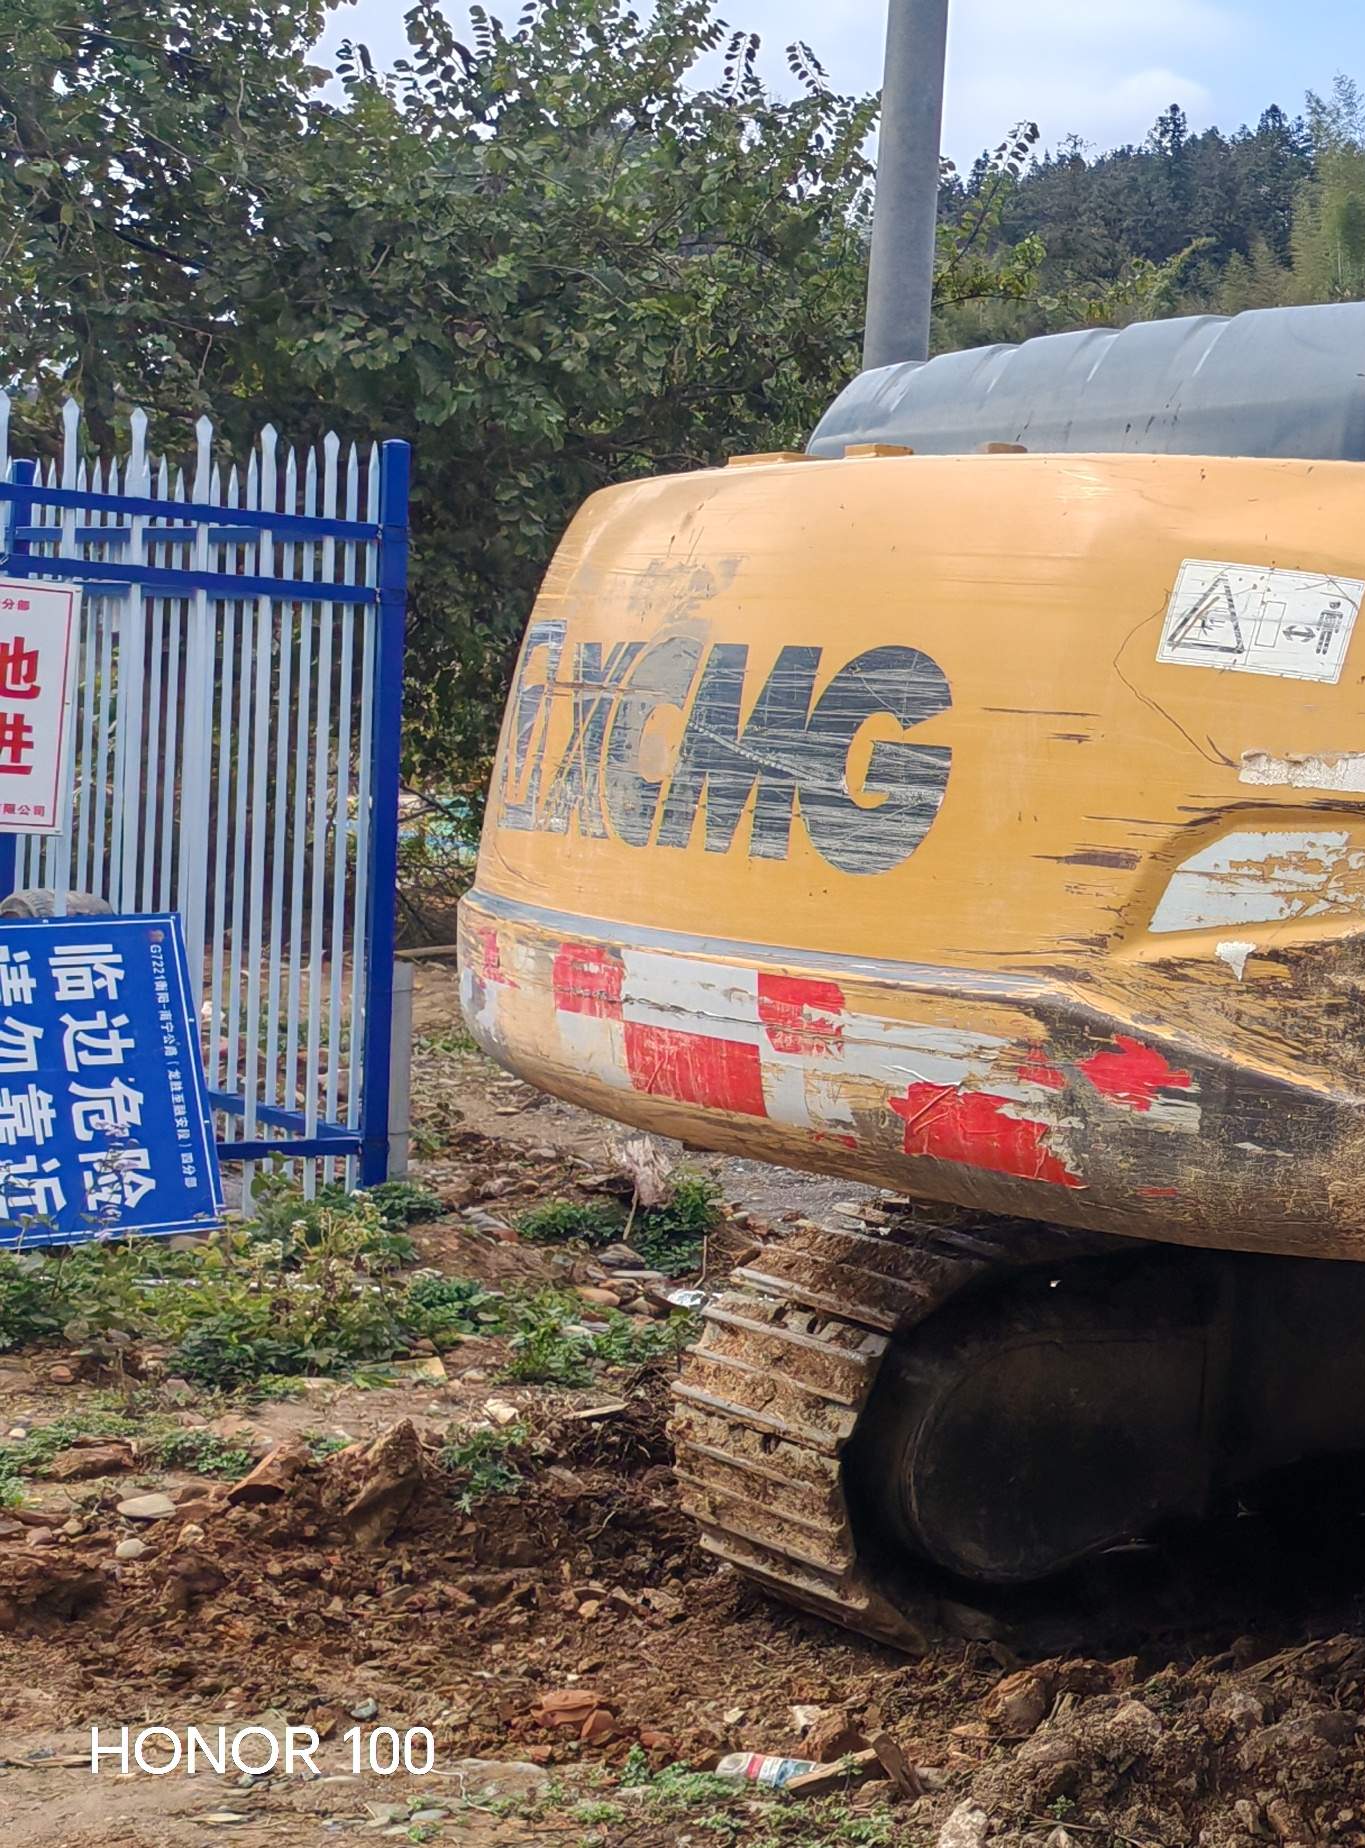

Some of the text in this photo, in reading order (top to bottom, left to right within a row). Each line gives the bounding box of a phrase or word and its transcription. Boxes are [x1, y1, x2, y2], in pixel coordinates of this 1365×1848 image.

[0, 803, 46, 817] 限公司
[546, 636, 953, 876] XCMG
[48, 943, 156, 1211] 临边危险
